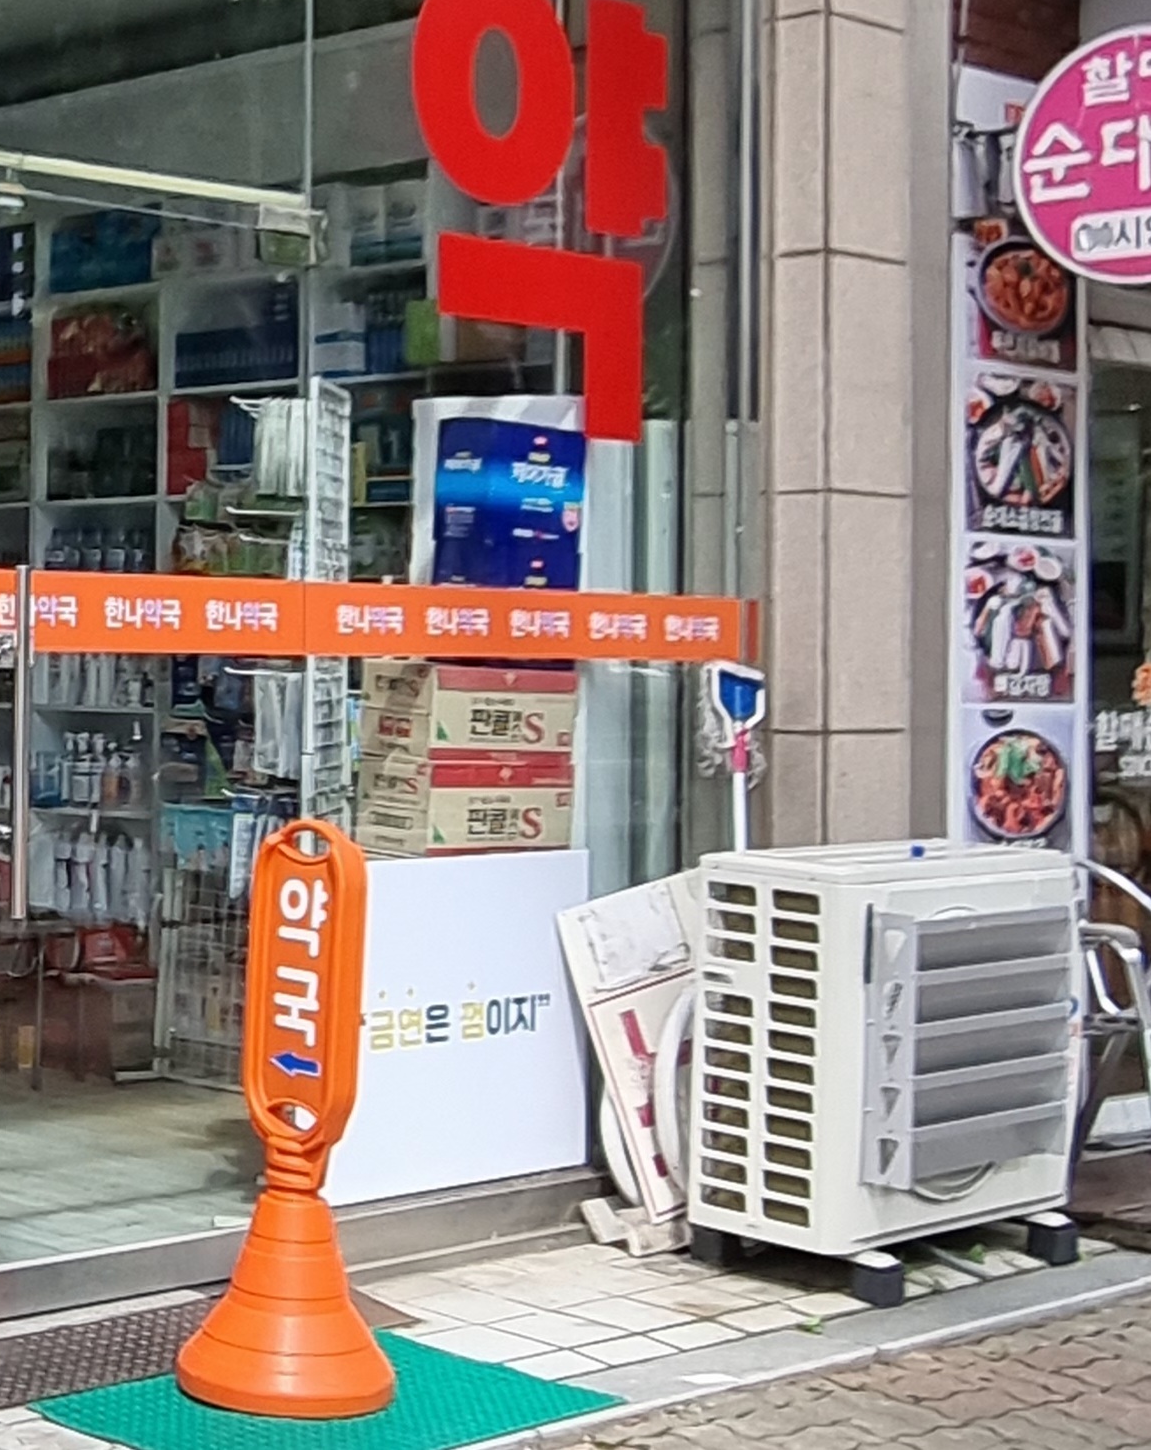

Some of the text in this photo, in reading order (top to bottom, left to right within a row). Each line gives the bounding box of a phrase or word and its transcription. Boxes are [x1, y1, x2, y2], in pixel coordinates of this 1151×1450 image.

[1082, 50, 1151, 107] 할
[104, 597, 181, 630] 한나약국
[205, 600, 278, 631] 한나약국
[336, 604, 405, 635] 한나약국
[425, 606, 491, 637] 한나약국
[510, 608, 570, 639] 한나약국
[589, 610, 647, 641] 한나약국
[663, 613, 720, 643] 한나약국
[273, 878, 329, 1048] 약국
